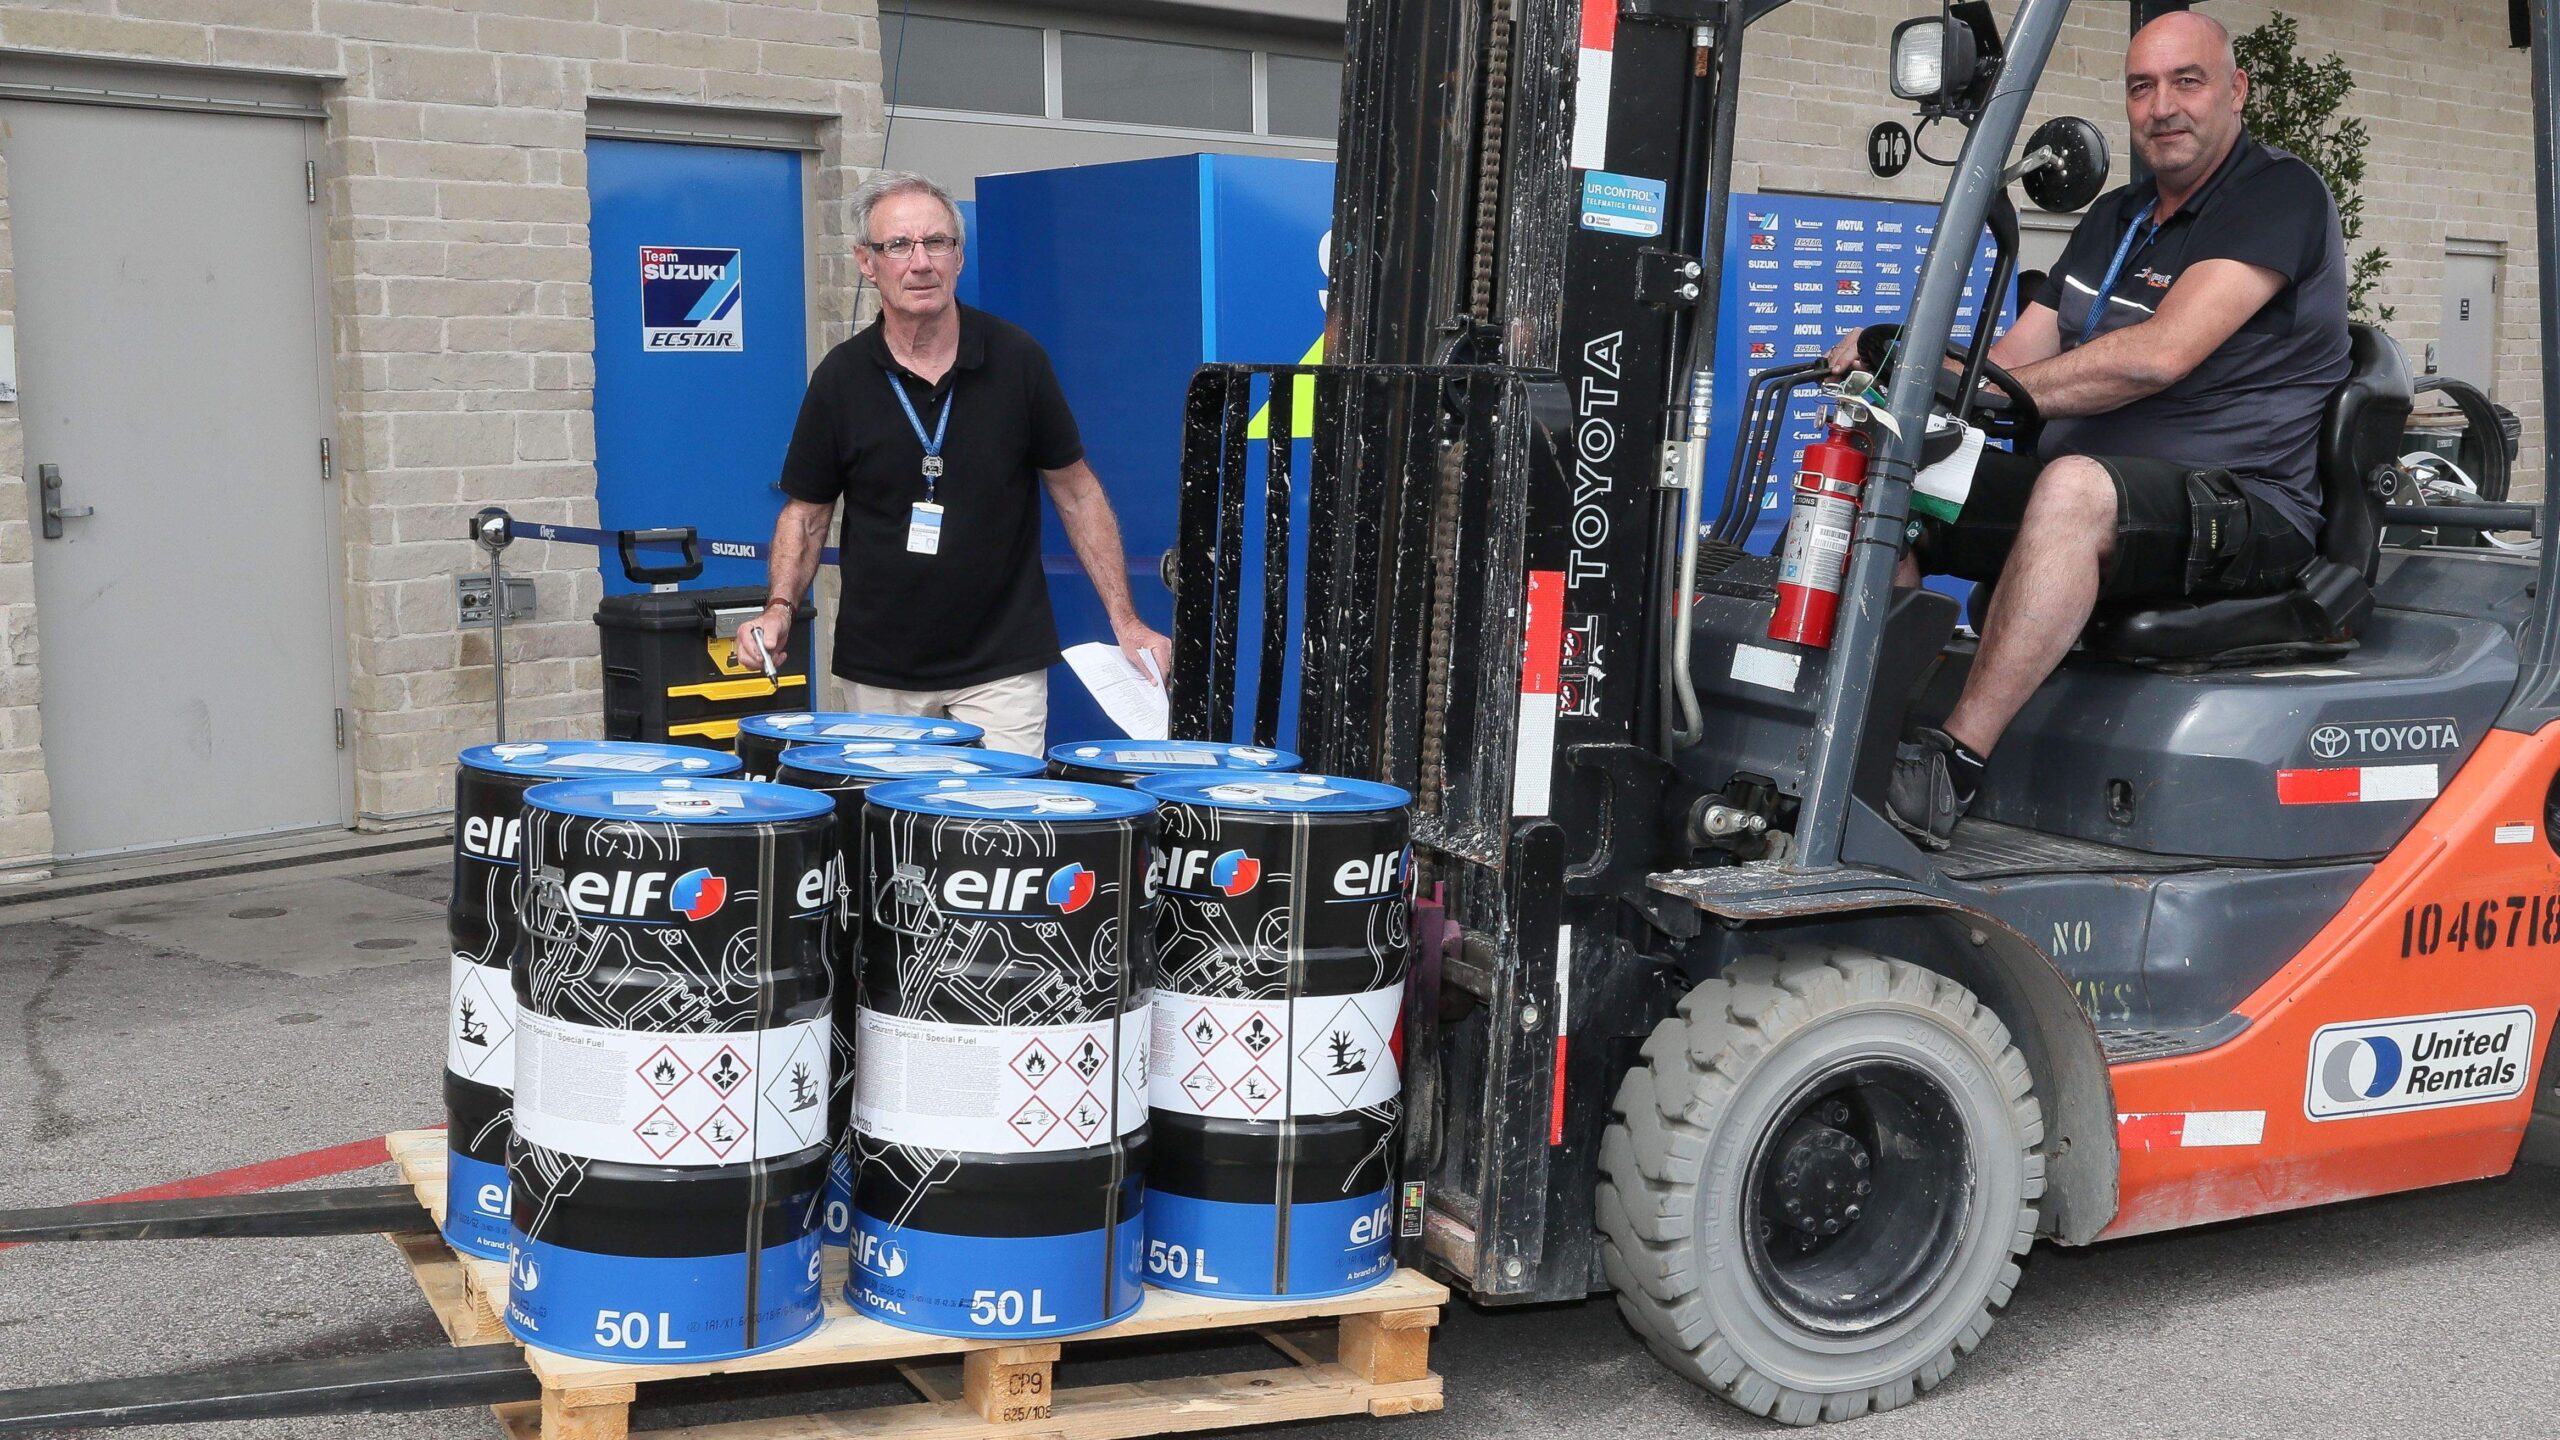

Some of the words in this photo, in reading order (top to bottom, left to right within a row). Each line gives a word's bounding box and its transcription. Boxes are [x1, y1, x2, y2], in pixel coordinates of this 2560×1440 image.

[1587, 183, 1602, 196] UR
[1604, 186, 1652, 202] CONTROL
[1586, 197, 1626, 209] TELEMATICS
[1627, 203, 1657, 214] ENABLED
[1836, 219, 1864, 231] MOTUL
[643, 250, 679, 263] Team
[1748, 260, 1779, 269] SUZUKI
[644, 263, 726, 281] SUZUKI
[1794, 282, 1823, 292] SUZUKI
[1835, 304, 1863, 313] SUZUKI
[650, 332, 737, 347] ECSTAR
[1793, 324, 1823, 335] MOTUL
[1568, 330, 1623, 589] TOYOTA
[712, 542, 755, 558] SUZUKI
[2354, 725, 2460, 752] TOYOTA
[1333, 850, 1399, 896] elf
[567, 870, 667, 917] elf
[943, 867, 1044, 912] elf
[2053, 921, 2091, 956] NO
[558, 1032, 584, 1045] Special
[586, 1039, 605, 1048] Fuel
[868, 1021, 893, 1036] Carburant
[926, 1033, 956, 1044] Special
[958, 1035, 977, 1045] Fuel
[2411, 1024, 2513, 1062] United
[2405, 1056, 2516, 1094] Rentals
[1349, 1202, 1389, 1245] elf
[483, 1238, 505, 1250] brand
[1149, 1239, 1189, 1280] 50
[1195, 1248, 1219, 1285] L
[1353, 1267, 1371, 1279] brand
[970, 1290, 1024, 1326] 50
[1031, 1288, 1057, 1325] L
[594, 1310, 650, 1349] 50
[658, 1312, 687, 1350] L
[1009, 1372, 1043, 1396] CP9
